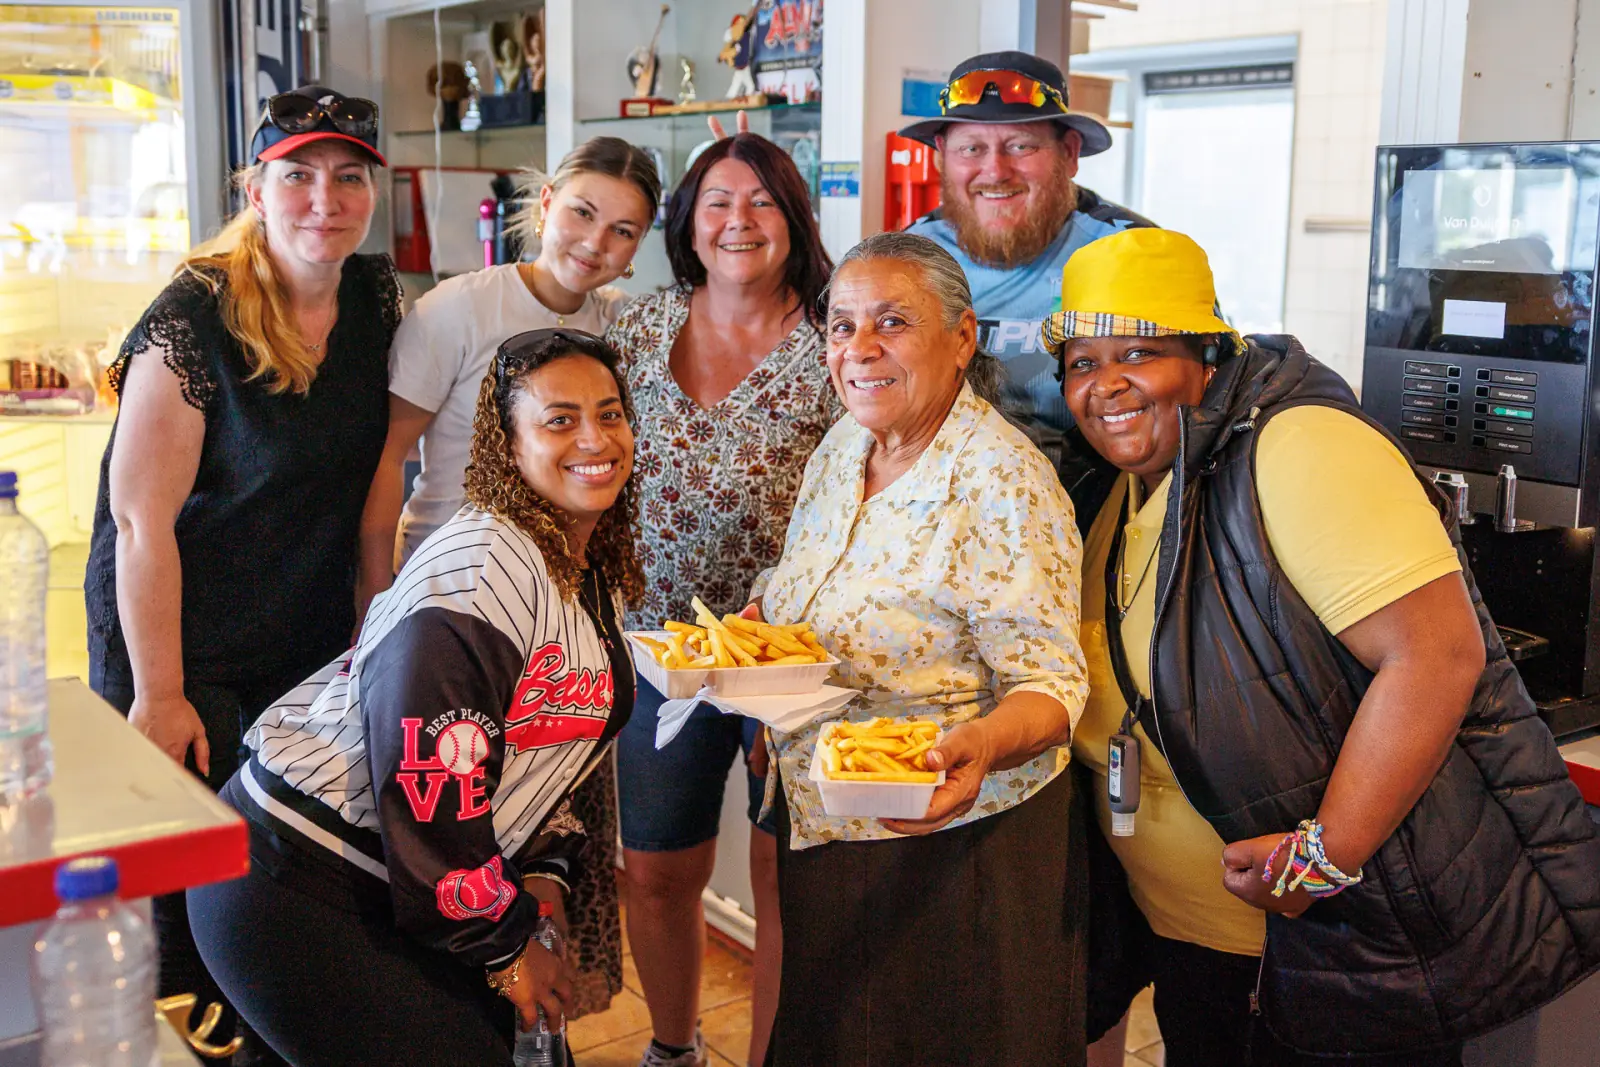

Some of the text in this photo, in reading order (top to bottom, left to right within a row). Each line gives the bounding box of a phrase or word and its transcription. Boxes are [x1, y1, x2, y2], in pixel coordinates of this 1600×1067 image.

[1444, 216, 1520, 233] Van Duijn
[425, 708, 500, 738] BEST PLAYER
